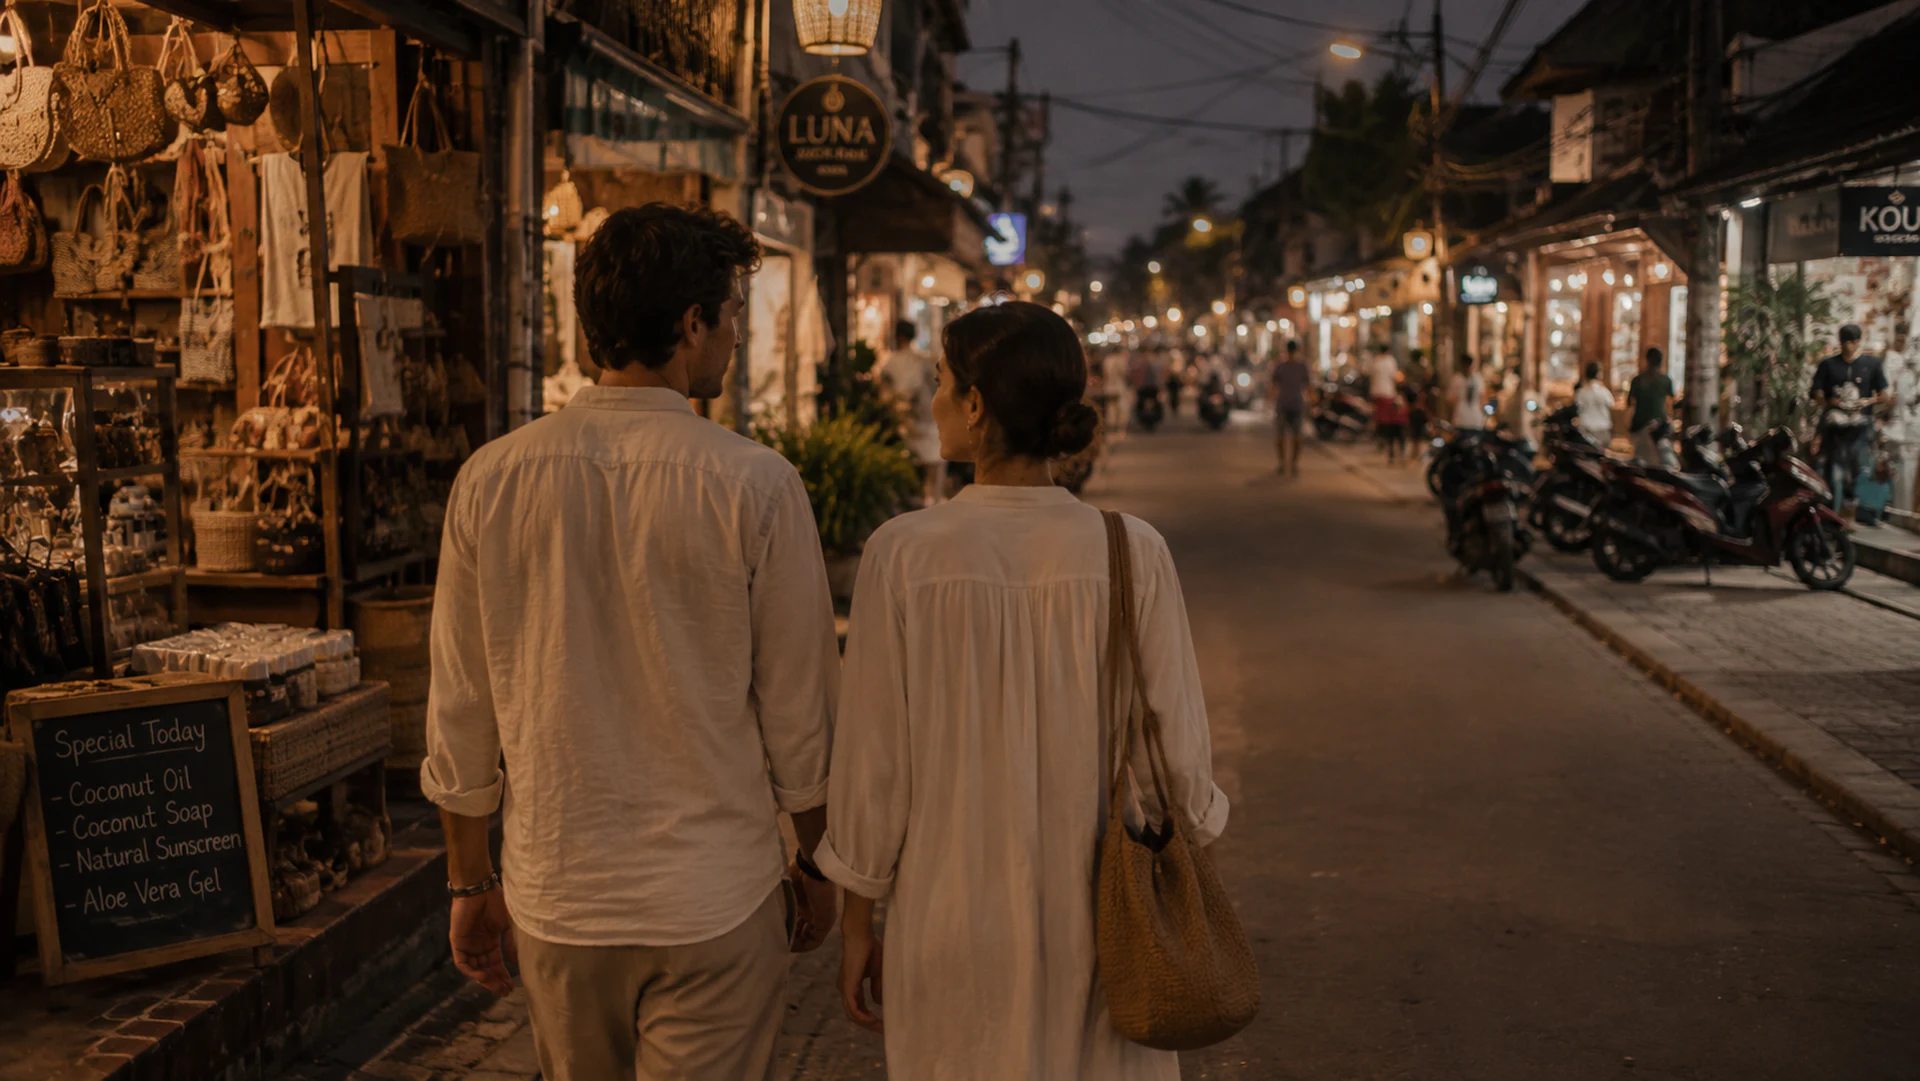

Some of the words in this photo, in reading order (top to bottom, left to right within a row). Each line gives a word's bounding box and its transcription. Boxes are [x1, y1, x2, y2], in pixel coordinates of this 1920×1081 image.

[788, 114, 877, 145] LUNA
[1859, 205, 1920, 233] KOU
[55, 724, 135, 767] Special
[141, 718, 206, 752] Today
[69, 773, 155, 807] Coconut
[163, 765, 192, 792] Oil
[72, 806, 157, 840] Coconut
[165, 800, 213, 828] Soap
[76, 838, 150, 874] Natural
[155, 832, 242, 860] Sunscreen
[84, 886, 129, 915] Aloe
[133, 878, 181, 905] Vera
[188, 867, 222, 901] Gel
